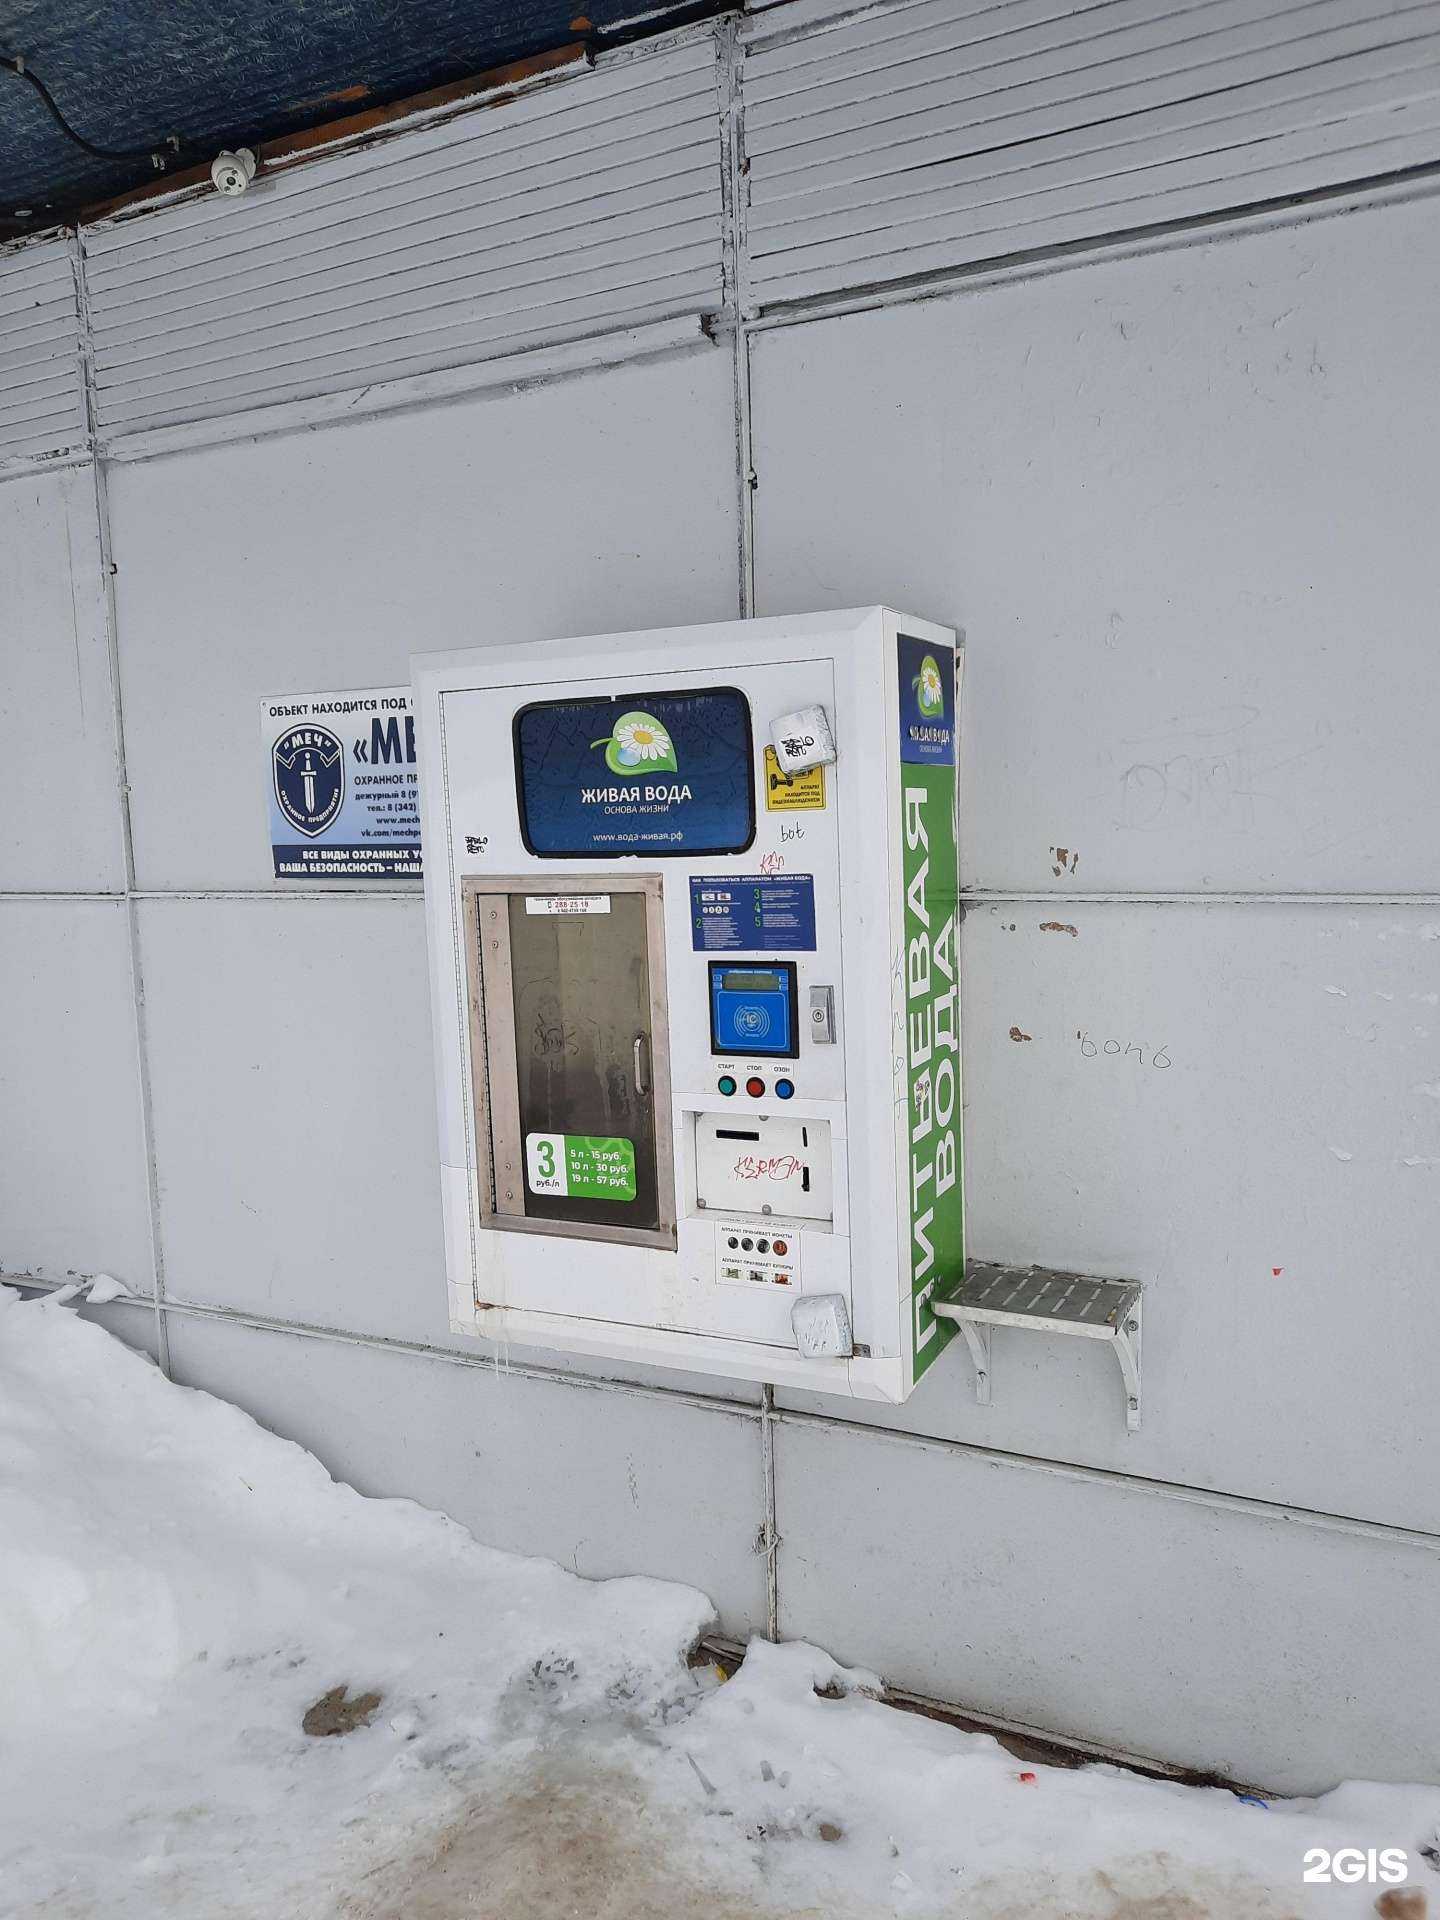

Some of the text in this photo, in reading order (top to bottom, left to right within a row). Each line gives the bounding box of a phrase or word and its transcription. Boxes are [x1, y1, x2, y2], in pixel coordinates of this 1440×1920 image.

[269, 705, 308, 717] ОБЪЕКТ
[312, 700, 377, 714] НАХОДИТСЯ
[381, 698, 407, 711] ПОД
[354, 775, 404, 786] ОХРАННОЕ
[355, 790, 419, 801] дежурный 8 (9
[581, 785, 692, 805] ЖИВАЯ ВОДА
[395, 802, 417, 813] (342)
[604, 804, 669, 815] ОСНОВА ЖИЗНИ
[592, 830, 684, 842] www.вода-живая.рф
[302, 850, 319, 860] ВСЕ
[321, 850, 349, 860] ВИДЫ
[352, 850, 409, 859] ОХРАННЫХ
[280, 863, 308, 873] ВАША
[310, 863, 385, 873] БЕЗОПАСНОСТЬ
[934, 909, 959, 1198] ВОДА
[905, 788, 937, 1354] ПИТЬЕВАЯ
[536, 1140, 556, 1178] 3
[570, 1149, 576, 1157] 5
[578, 1150, 584, 1158] л
[592, 1150, 600, 1160] 15
[602, 1152, 621, 1162] руб.
[571, 1162, 580, 1170] 10
[596, 1163, 607, 1172] 30
[609, 1165, 629, 1174] руб.
[536, 1179, 560, 1188] руб./л
[572, 1174, 580, 1183] 19
[583, 1175, 589, 1183] л
[596, 1175, 607, 1184] 57
[609, 1177, 629, 1187] руб.
